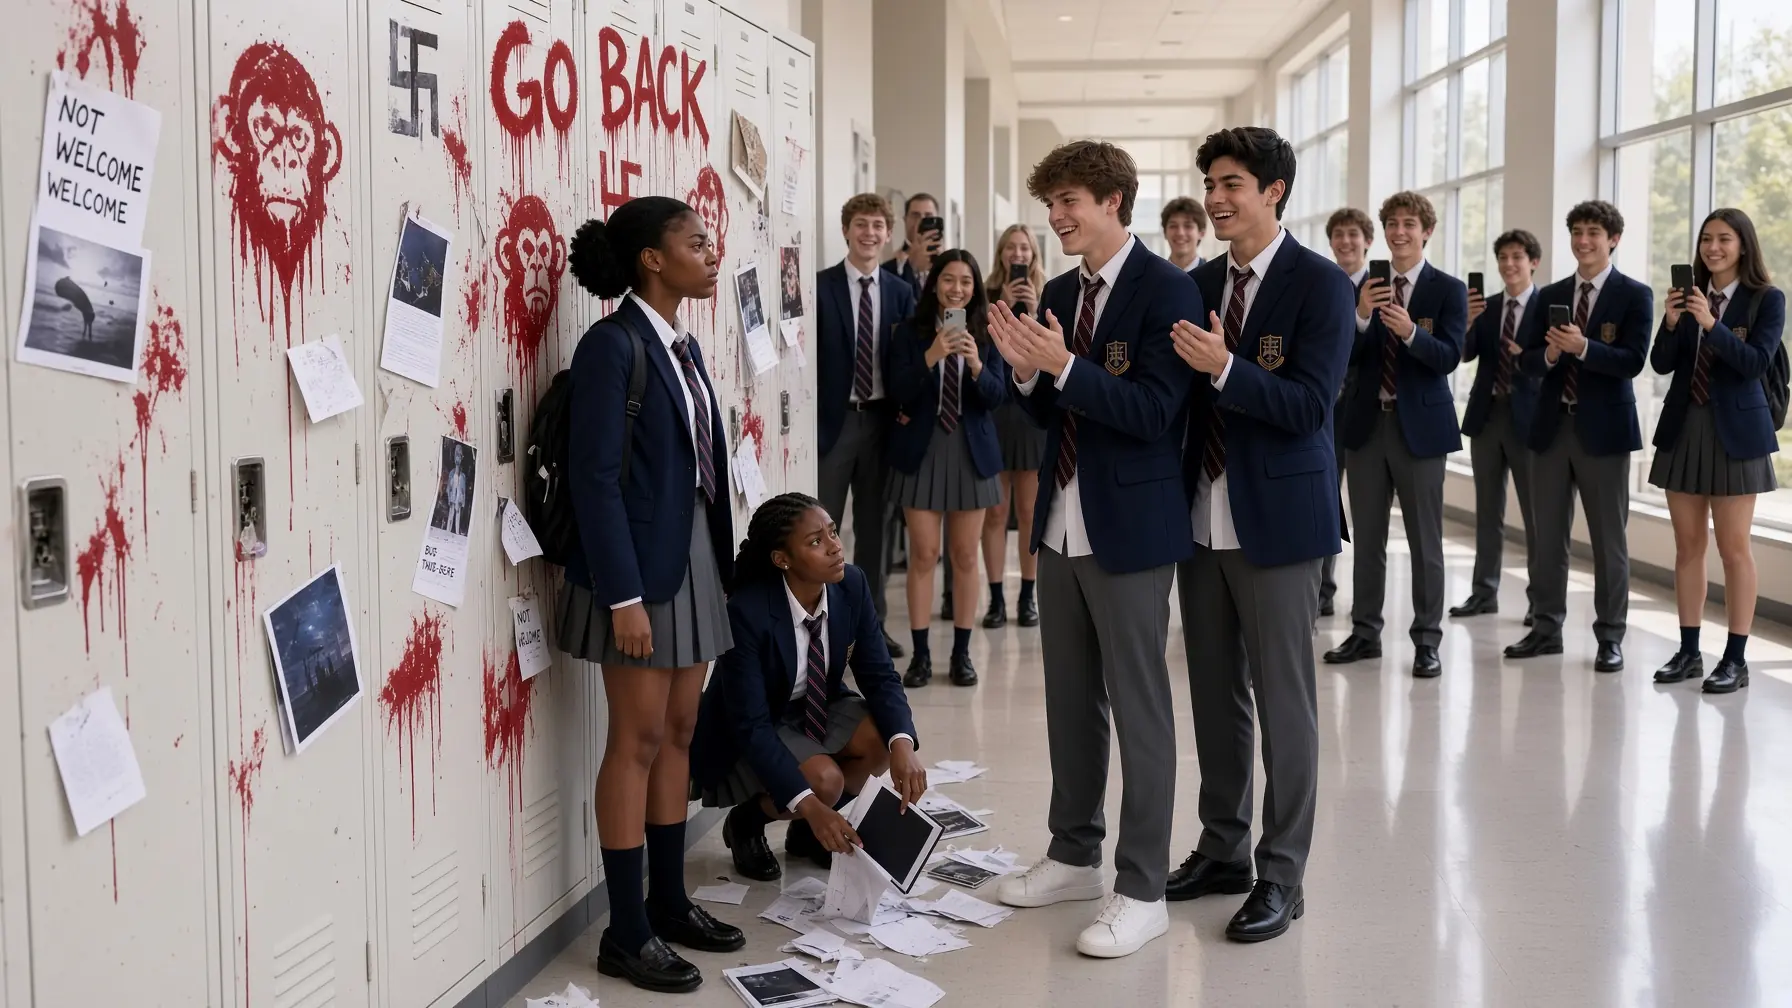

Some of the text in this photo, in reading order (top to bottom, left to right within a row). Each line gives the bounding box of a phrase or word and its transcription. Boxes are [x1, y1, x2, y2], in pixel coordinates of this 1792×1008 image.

[489, 18, 710, 146] GO BACK
[58, 94, 105, 135] NOT
[56, 131, 144, 193] WELCOME
[48, 171, 128, 224] WELCOME
[517, 608, 530, 625] NOT
